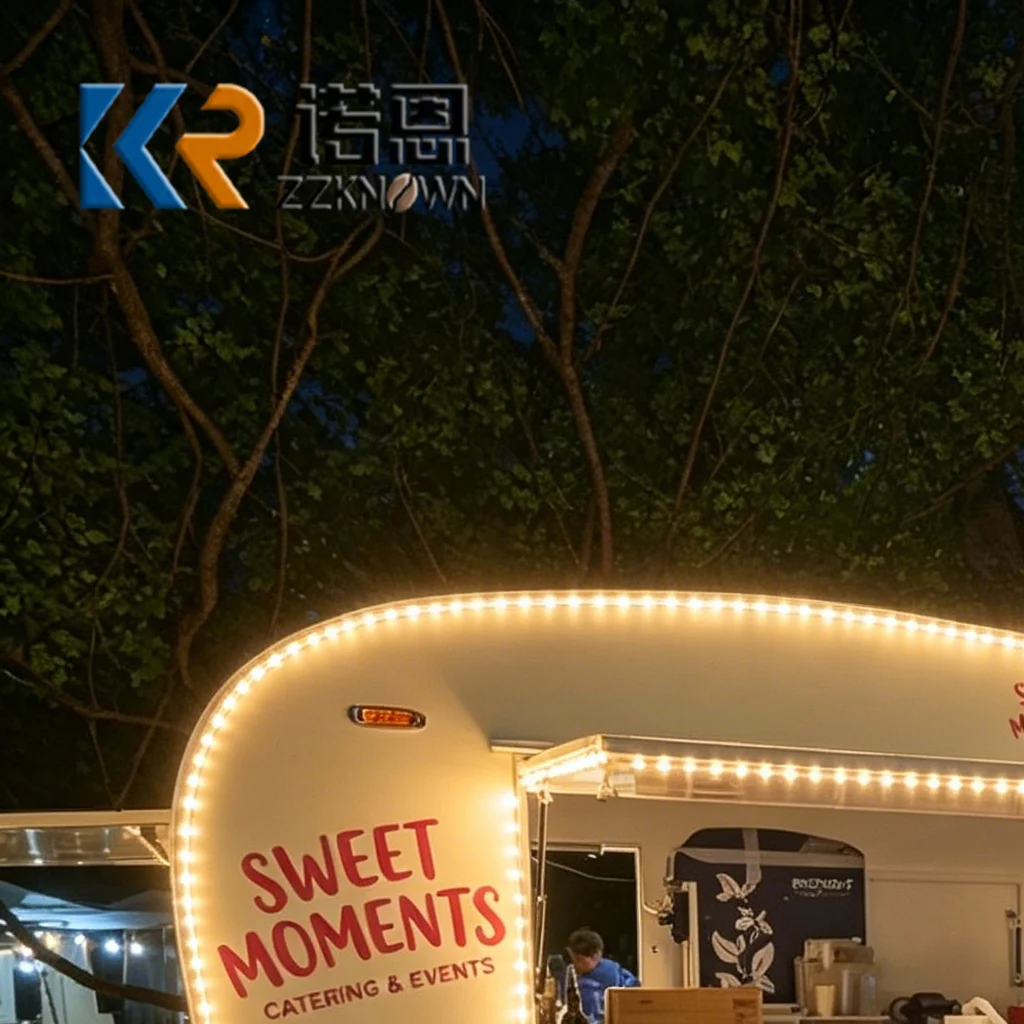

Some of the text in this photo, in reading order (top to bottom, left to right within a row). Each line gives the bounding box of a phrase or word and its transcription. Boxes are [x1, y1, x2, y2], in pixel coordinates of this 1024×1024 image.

[241, 818, 439, 914] SWEET
[217, 885, 506, 998] MOMENTS
[264, 957, 495, 1020] CATERING & EVENTS
